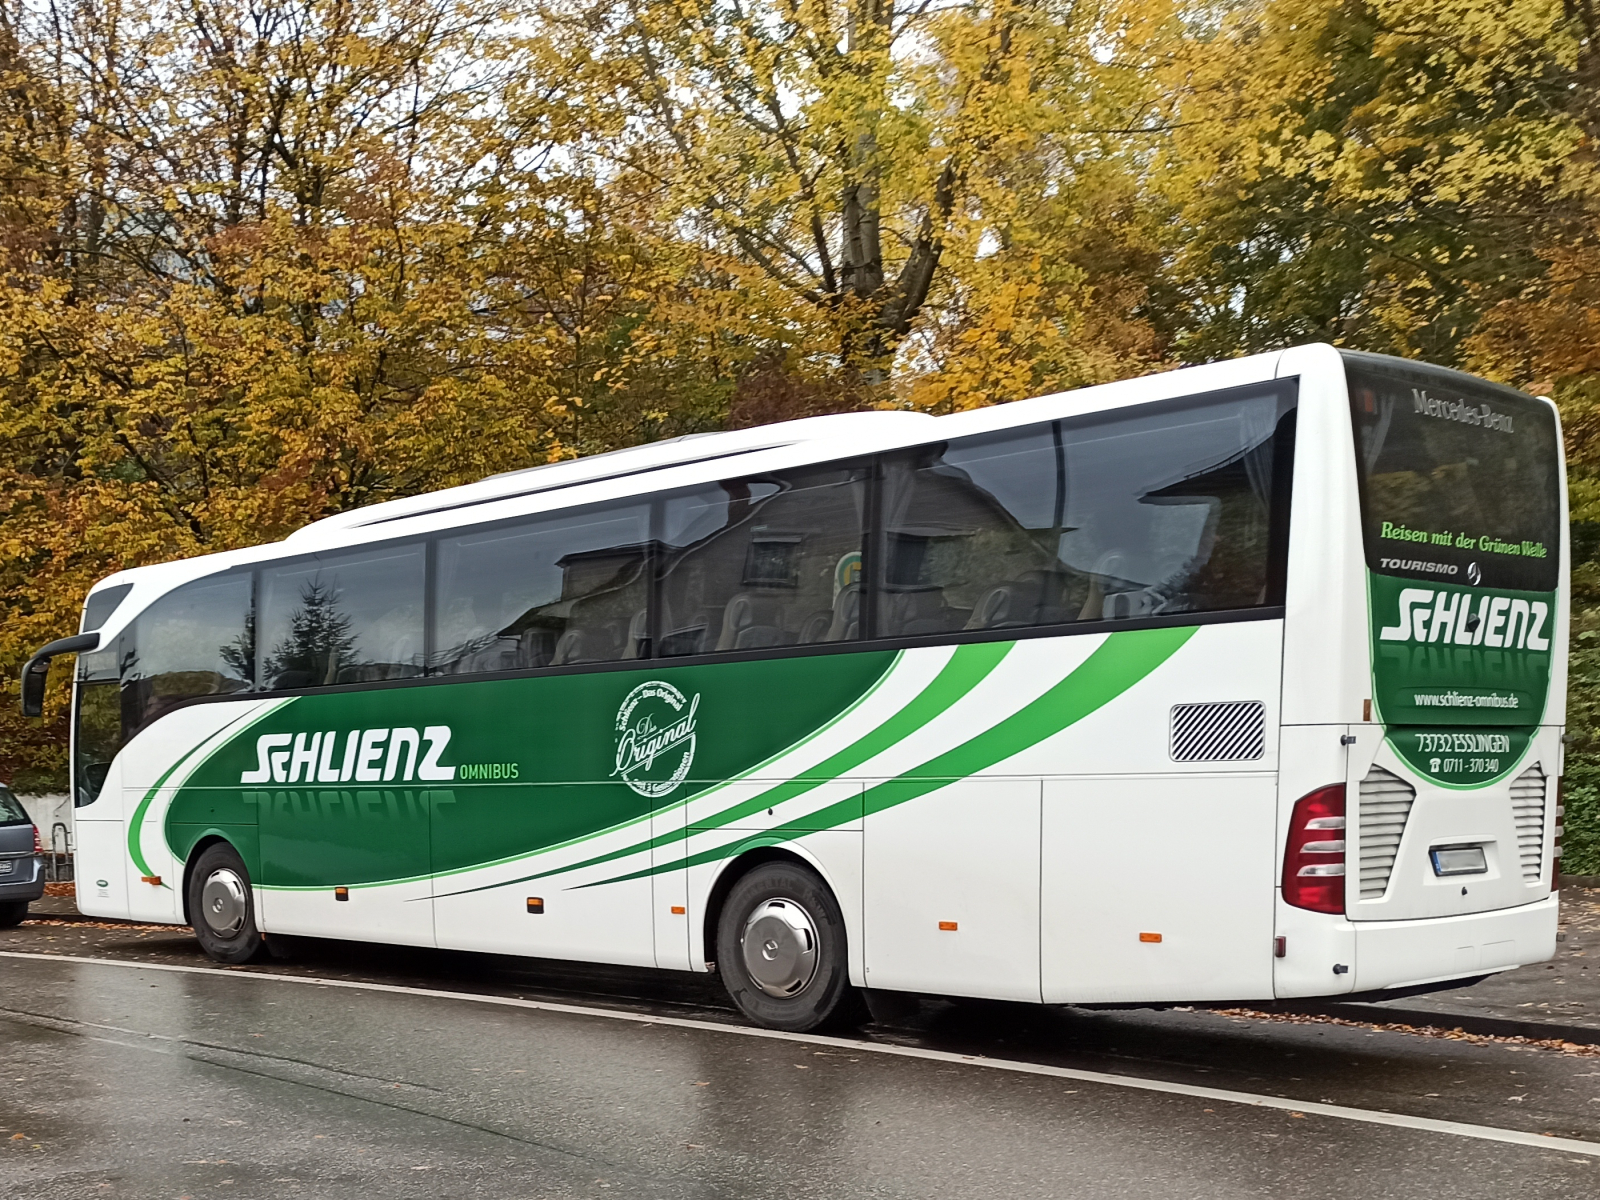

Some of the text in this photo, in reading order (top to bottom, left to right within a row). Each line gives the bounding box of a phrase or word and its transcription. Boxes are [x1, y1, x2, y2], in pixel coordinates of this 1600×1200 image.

[1411, 388, 1514, 434] Mercedes-Benz
[1380, 521, 1548, 559] Reisen mit der Grünen Welle
[1380, 558, 1459, 575] TOURISMO
[1379, 588, 1550, 651] SCHLIENZ
[1414, 690, 1519, 709] www.schlienz-omnibus.de
[608, 692, 701, 778] Original
[1414, 733, 1510, 754] 73732 ESSLINGEN
[240, 725, 520, 784] SCHLIENZ OMNIBUS
[1443, 758, 1463, 773] 0711
